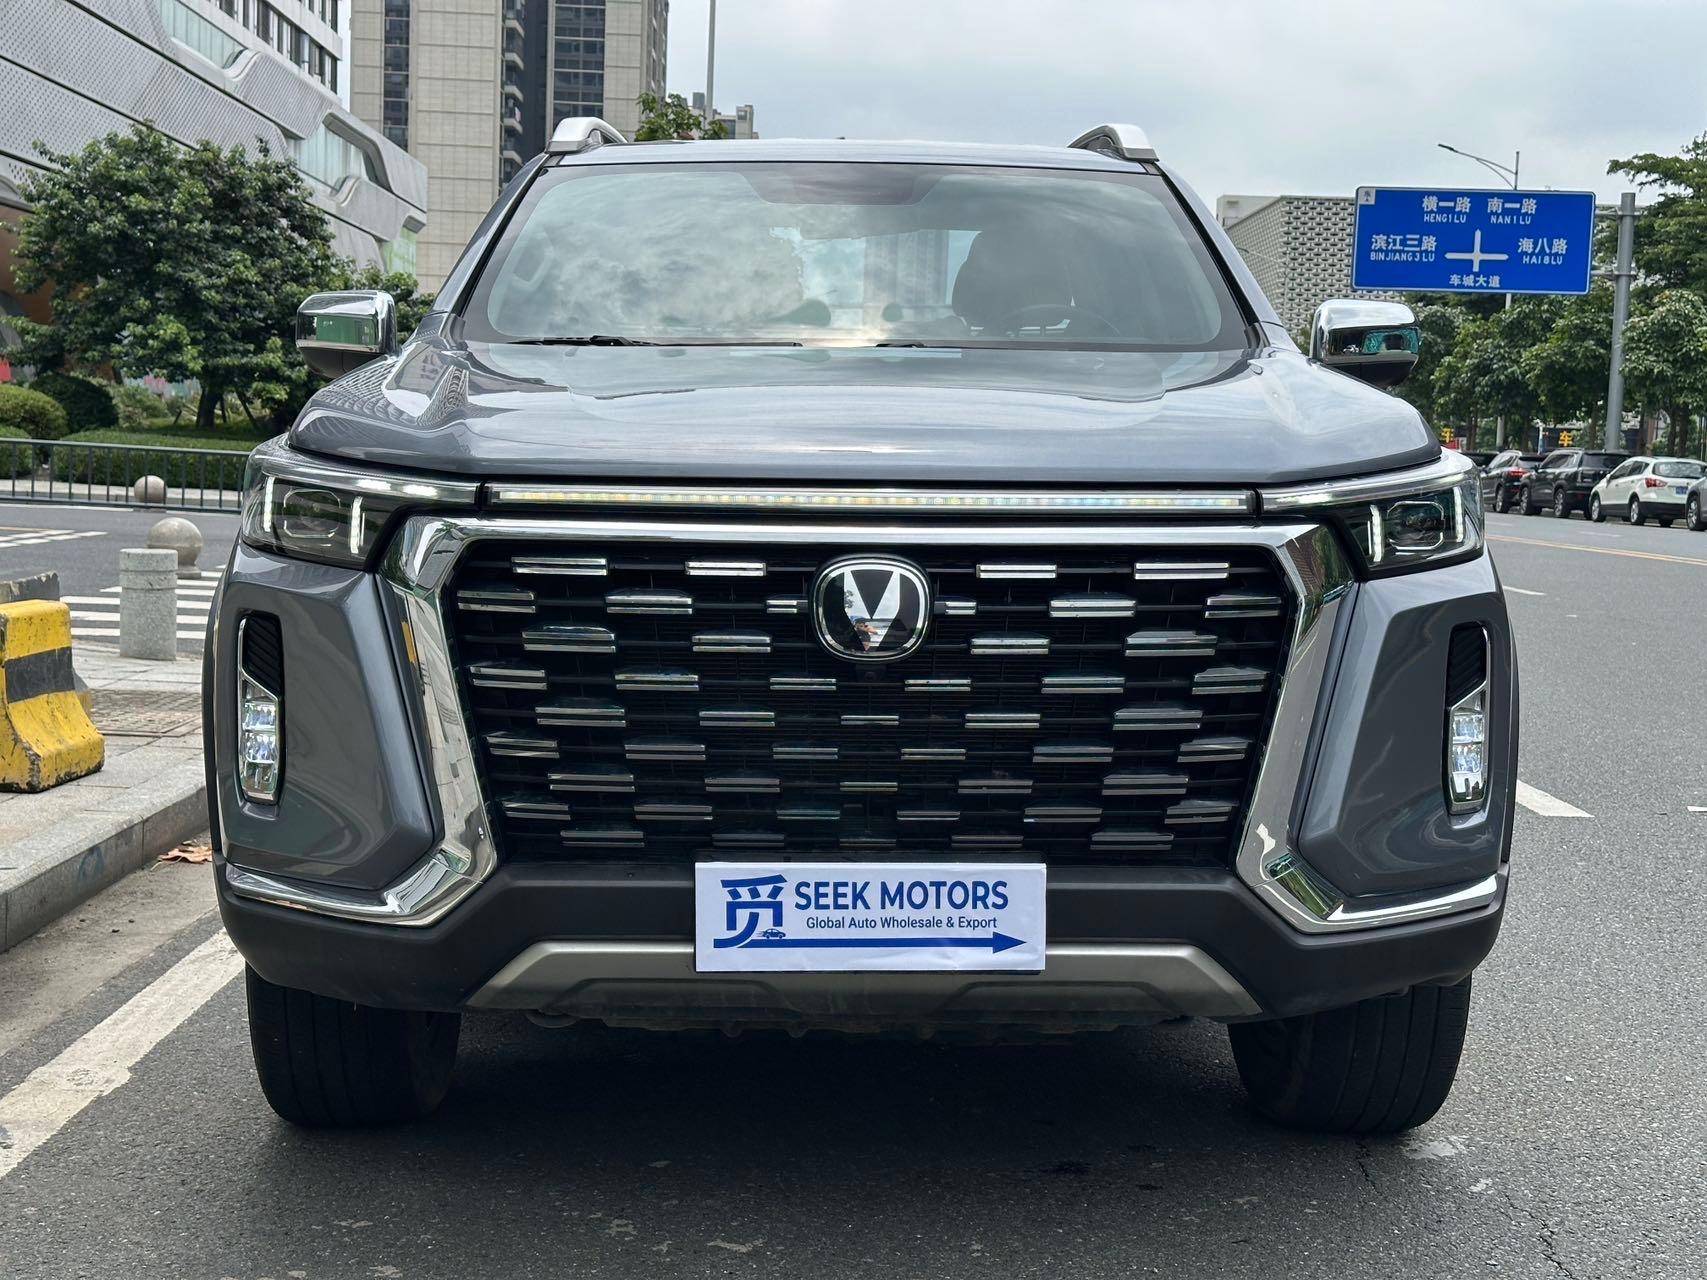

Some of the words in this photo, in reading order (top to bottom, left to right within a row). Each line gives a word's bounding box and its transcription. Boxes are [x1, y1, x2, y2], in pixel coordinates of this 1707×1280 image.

[1422, 195, 1471, 213] 横一路
[1487, 197, 1537, 214] 南一路
[1371, 234, 1437, 251] 滨江三路
[1517, 237, 1568, 254] 海八路
[1449, 274, 1501, 288] 车城大道
[794, 880, 871, 911] SEEK
[880, 880, 1009, 911] MOTORS
[806, 915, 845, 930] Global
[848, 915, 877, 930] Auto
[879, 915, 943, 930] Wholesale
[945, 916, 955, 929] &
[957, 915, 998, 932] Export
